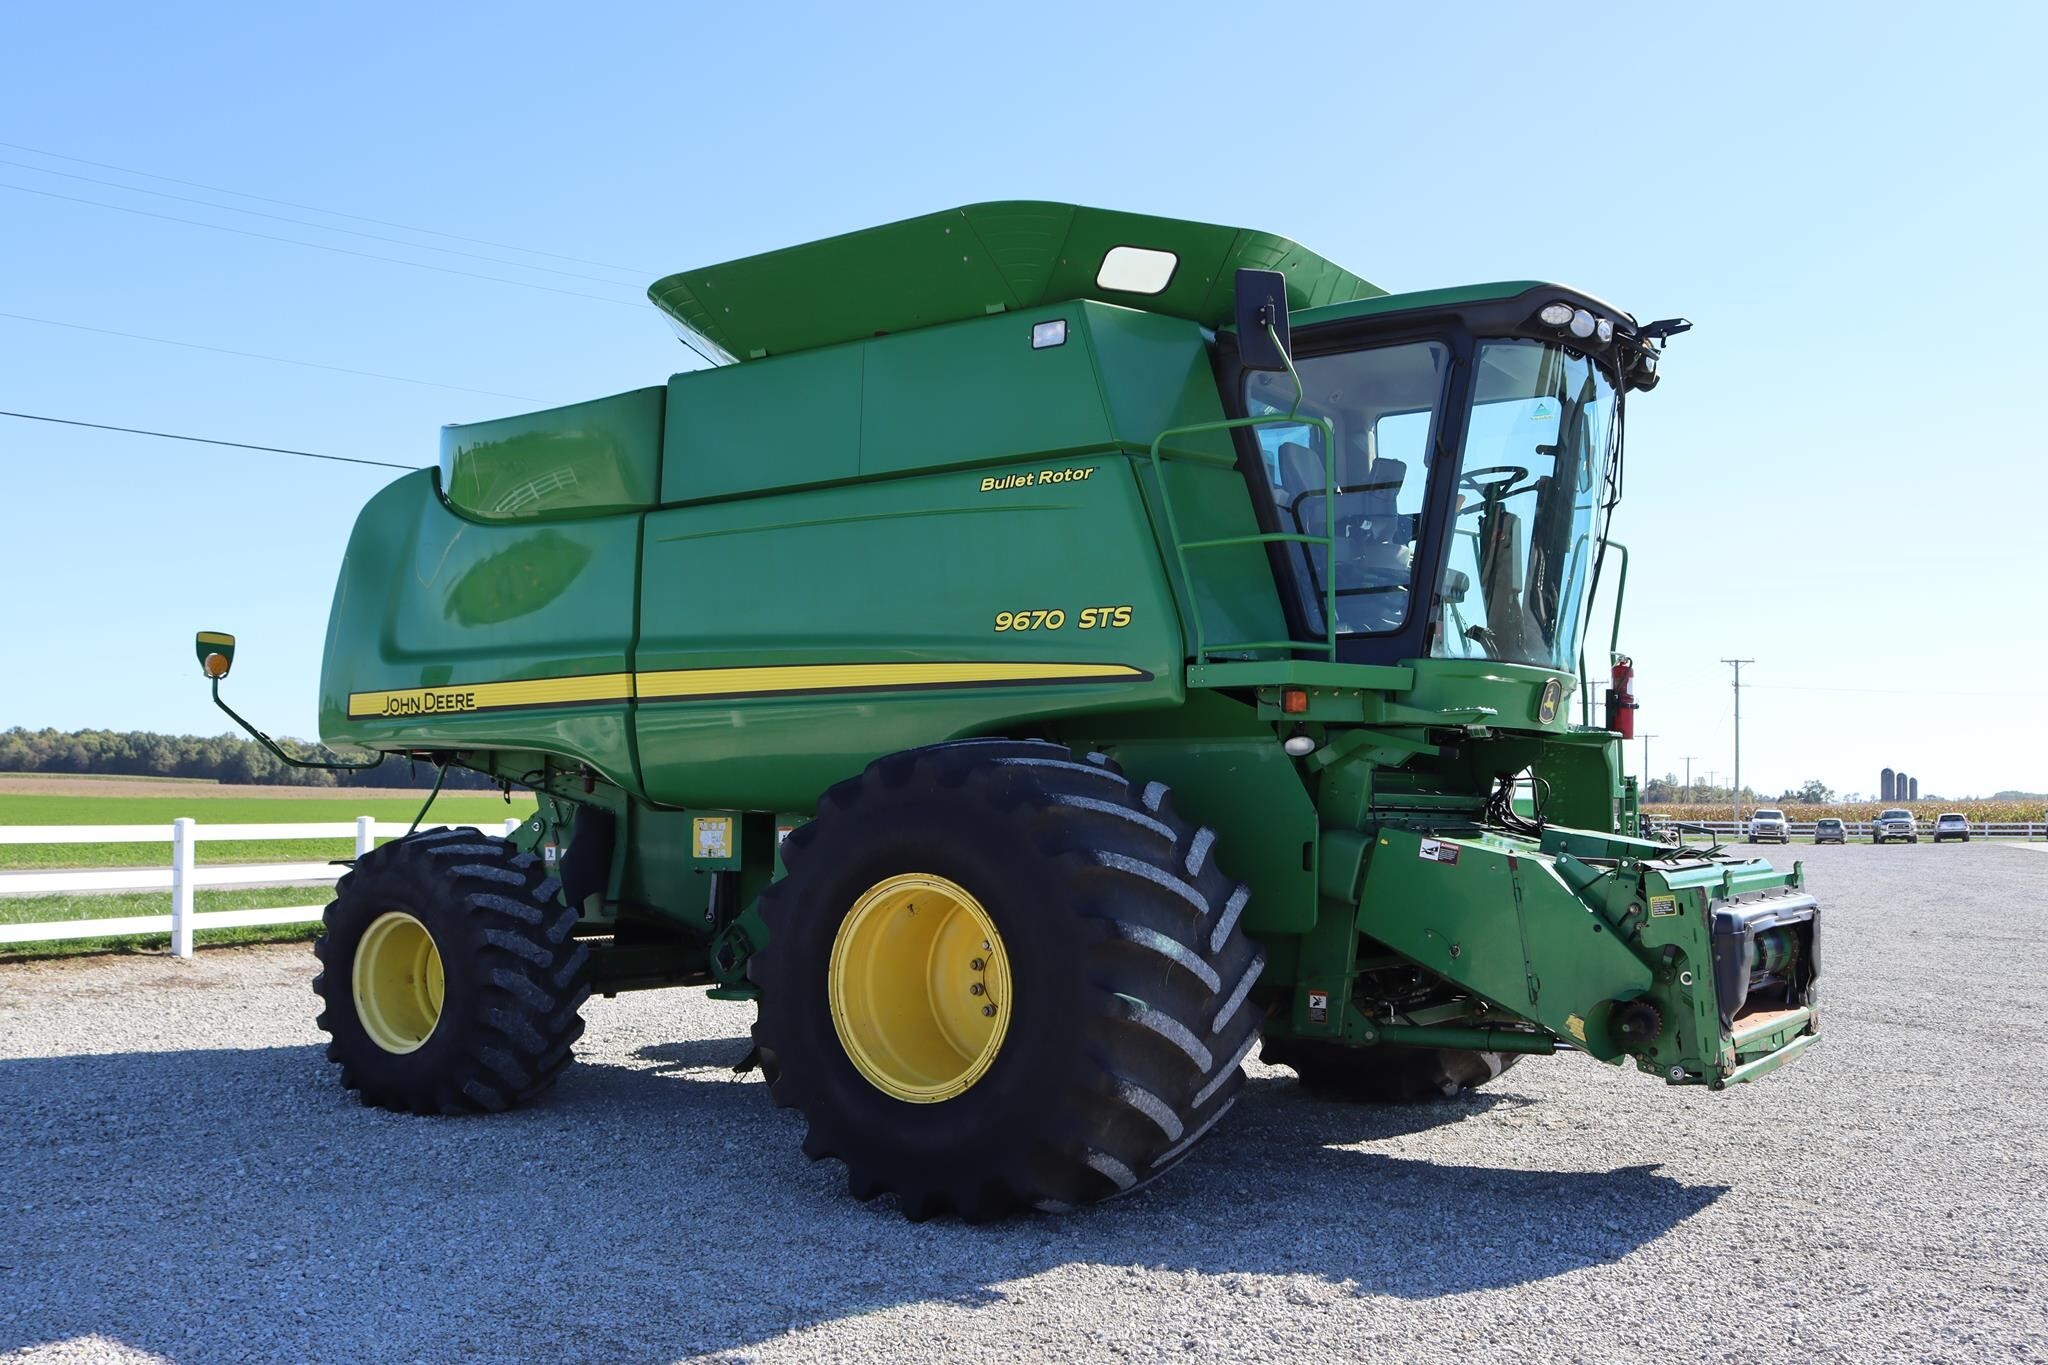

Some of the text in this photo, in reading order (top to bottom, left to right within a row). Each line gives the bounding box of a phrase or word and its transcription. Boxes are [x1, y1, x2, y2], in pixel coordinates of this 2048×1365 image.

[980, 467, 1094, 491] Bullet Rotor
[994, 605, 1133, 632] 9670 STS
[382, 693, 475, 714] JOHN DEERE
